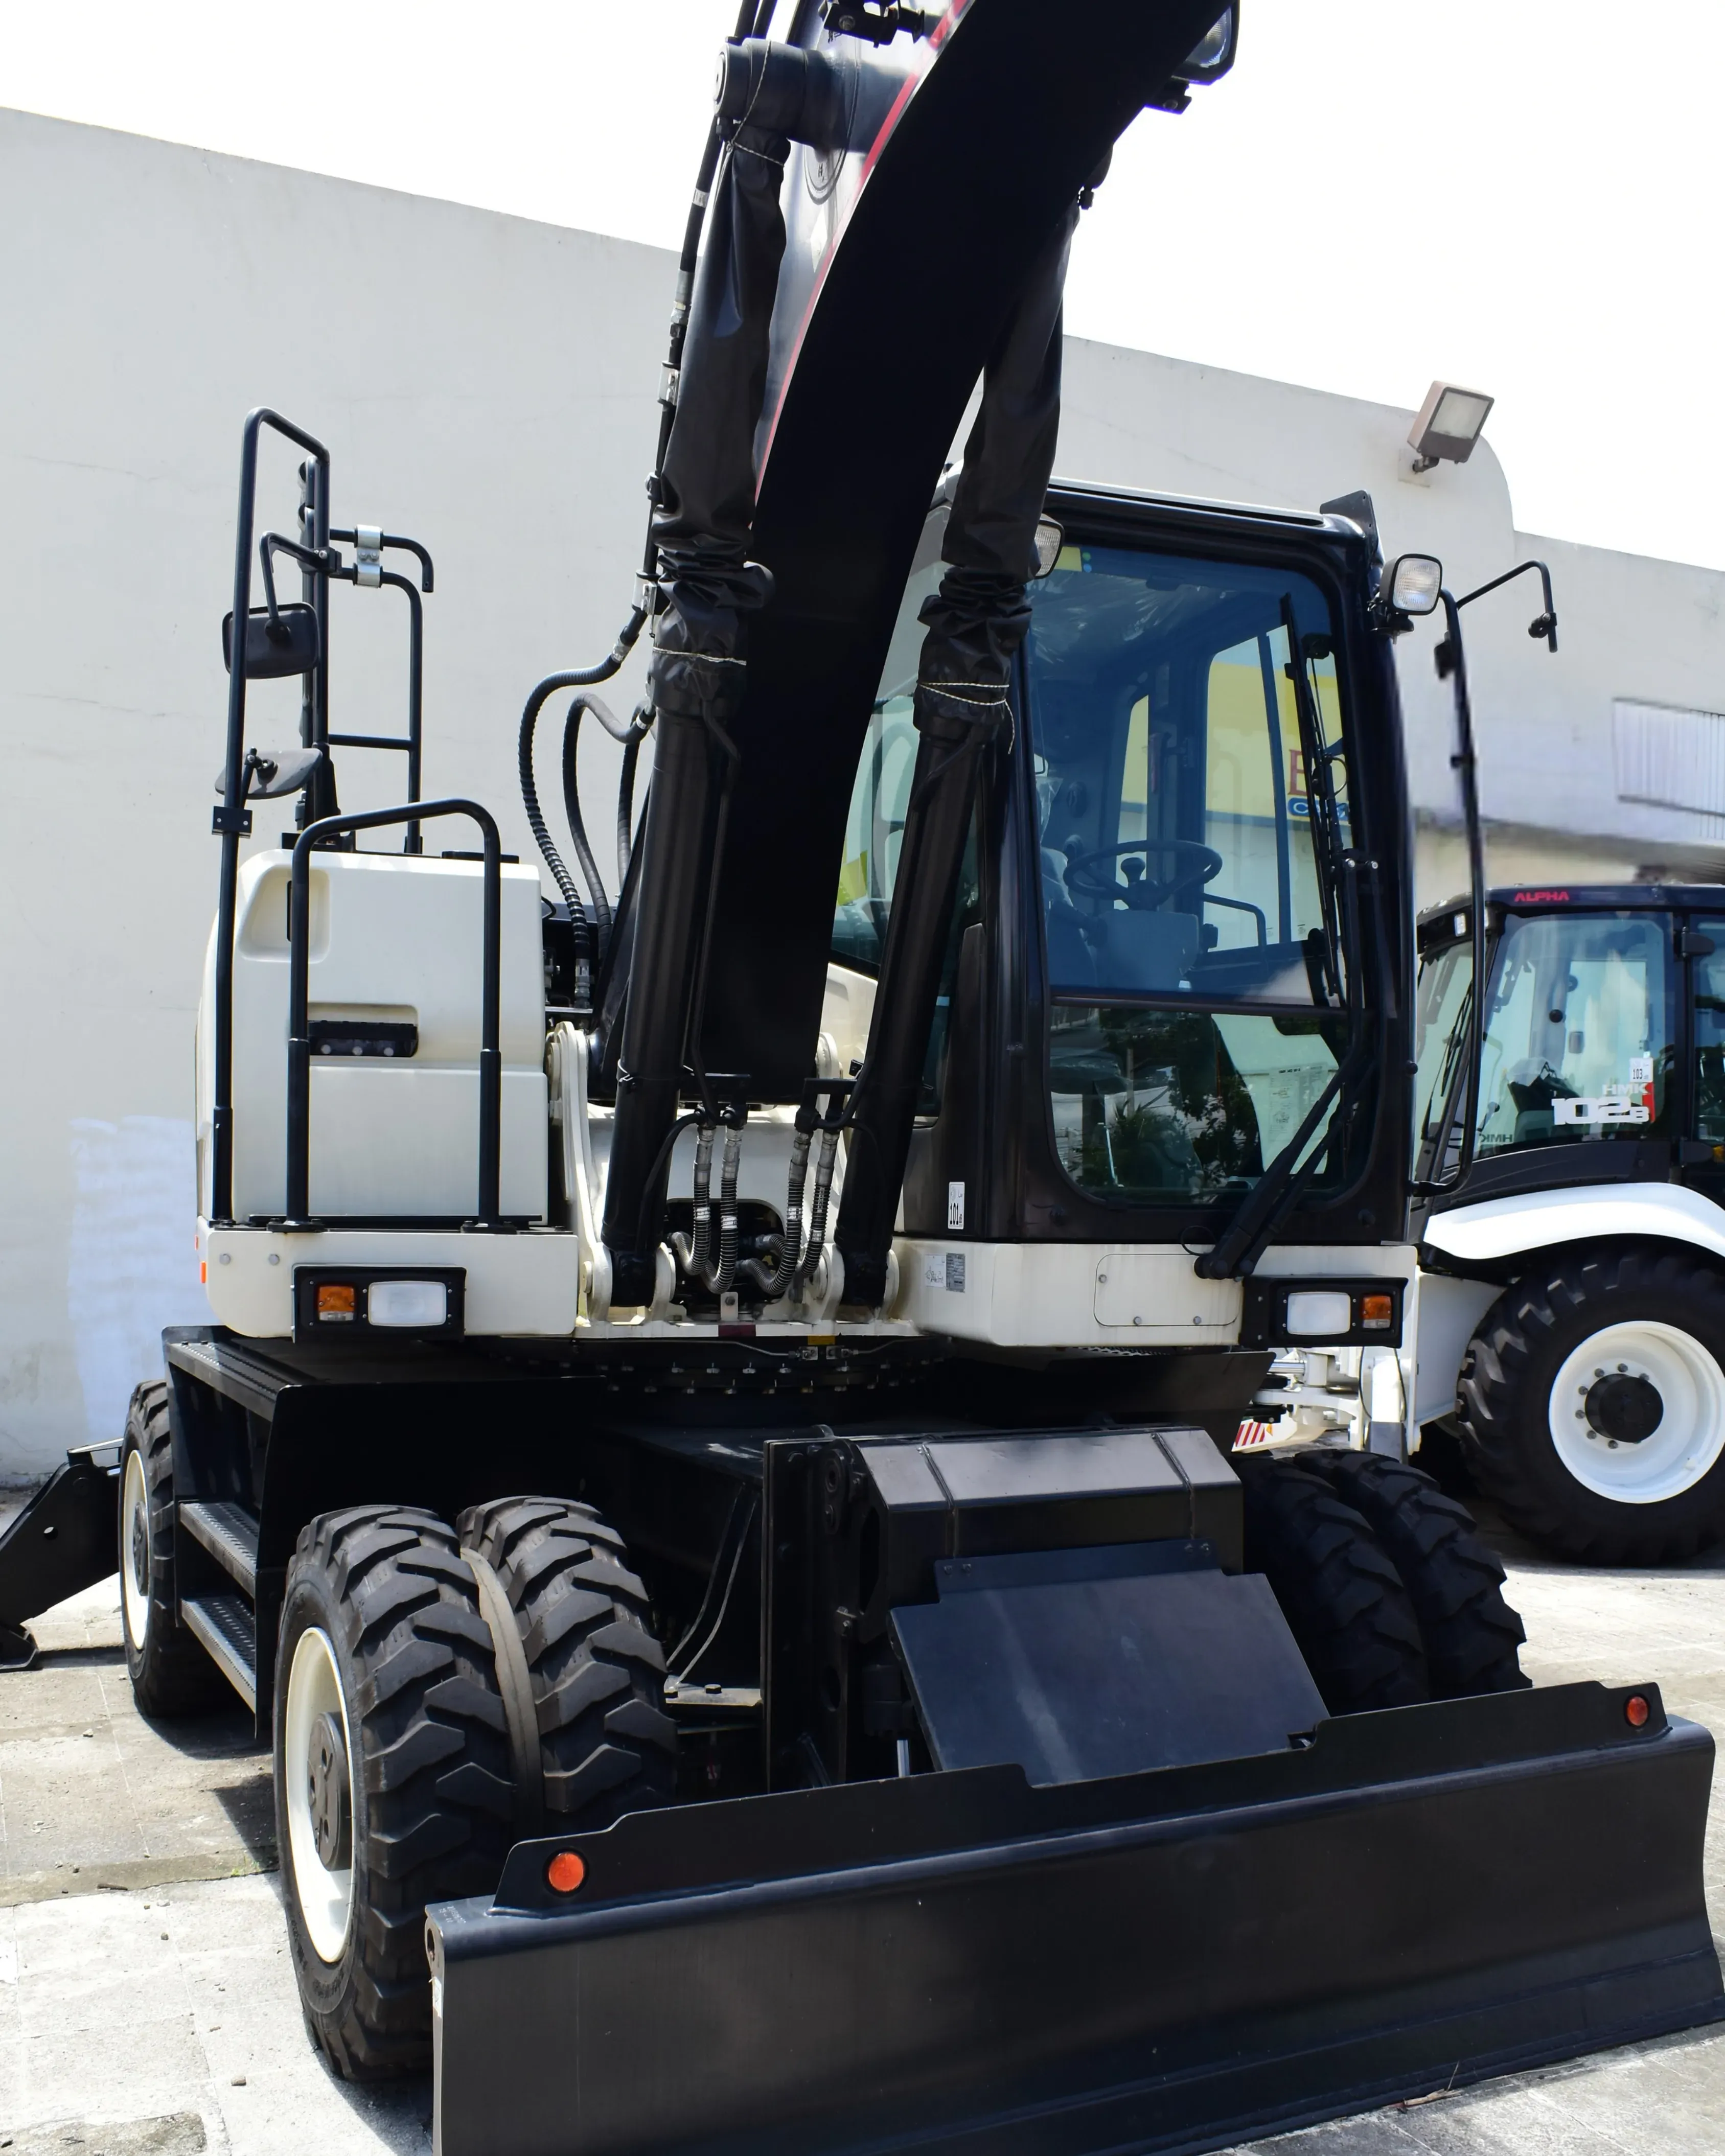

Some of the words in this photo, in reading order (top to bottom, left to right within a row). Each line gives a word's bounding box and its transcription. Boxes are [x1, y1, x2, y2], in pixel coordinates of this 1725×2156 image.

[1514, 891, 1570, 902] ALPHA
[1632, 1068, 1643, 1079] 103
[1602, 1082, 1648, 1095] HMK
[950, 1202, 959, 1225] 101
